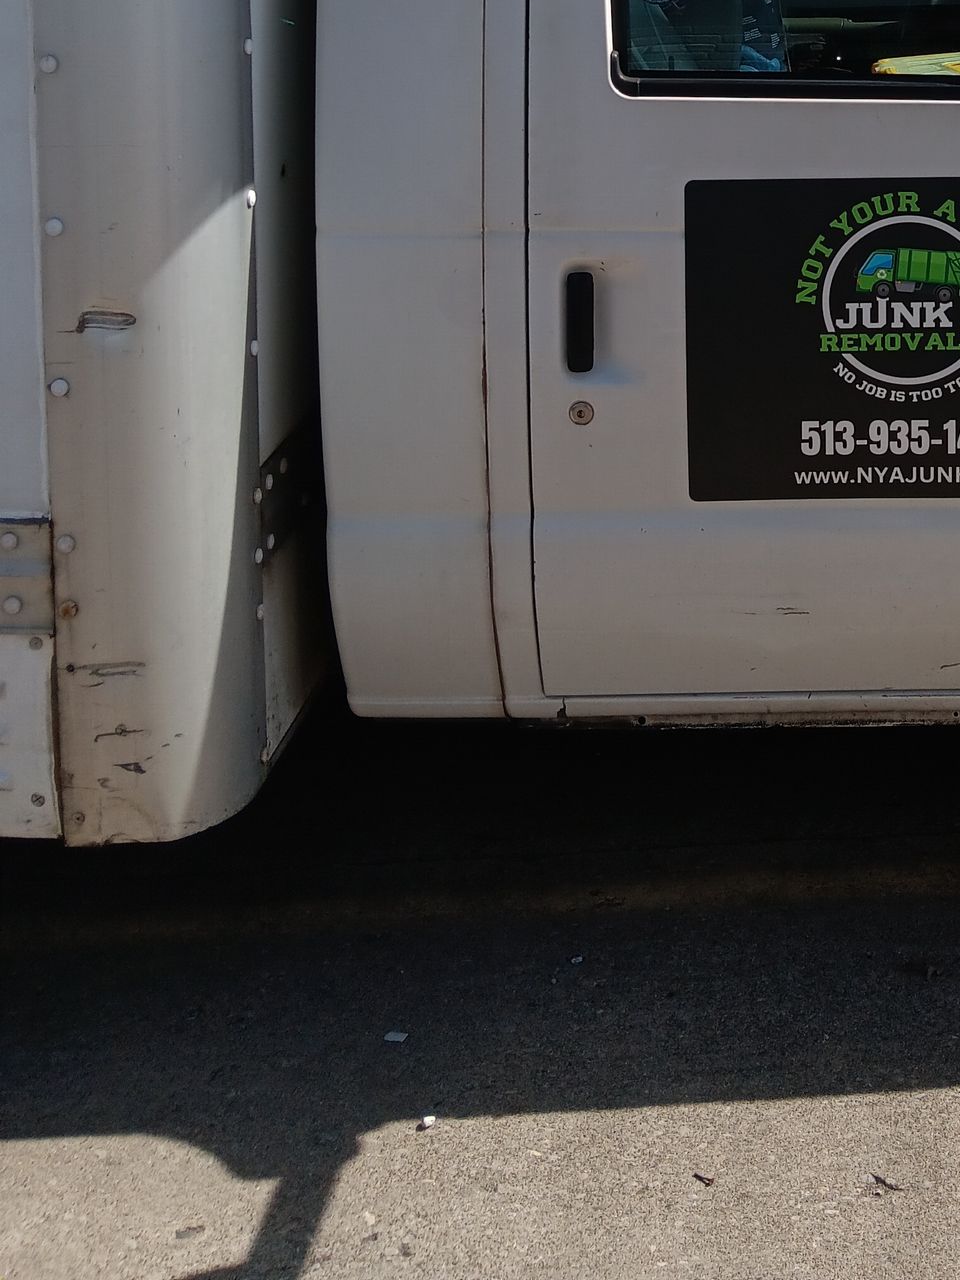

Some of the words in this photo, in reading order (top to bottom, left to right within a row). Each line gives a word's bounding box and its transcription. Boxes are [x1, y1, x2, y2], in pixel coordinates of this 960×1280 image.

[795, 234, 834, 305] NOT
[829, 191, 921, 236] YOUR
[835, 296, 953, 329] JUNK
[832, 361, 857, 384] NO
[855, 380, 888, 399] JOB
[889, 389, 906, 403] IS
[908, 386, 943, 403] TOO
